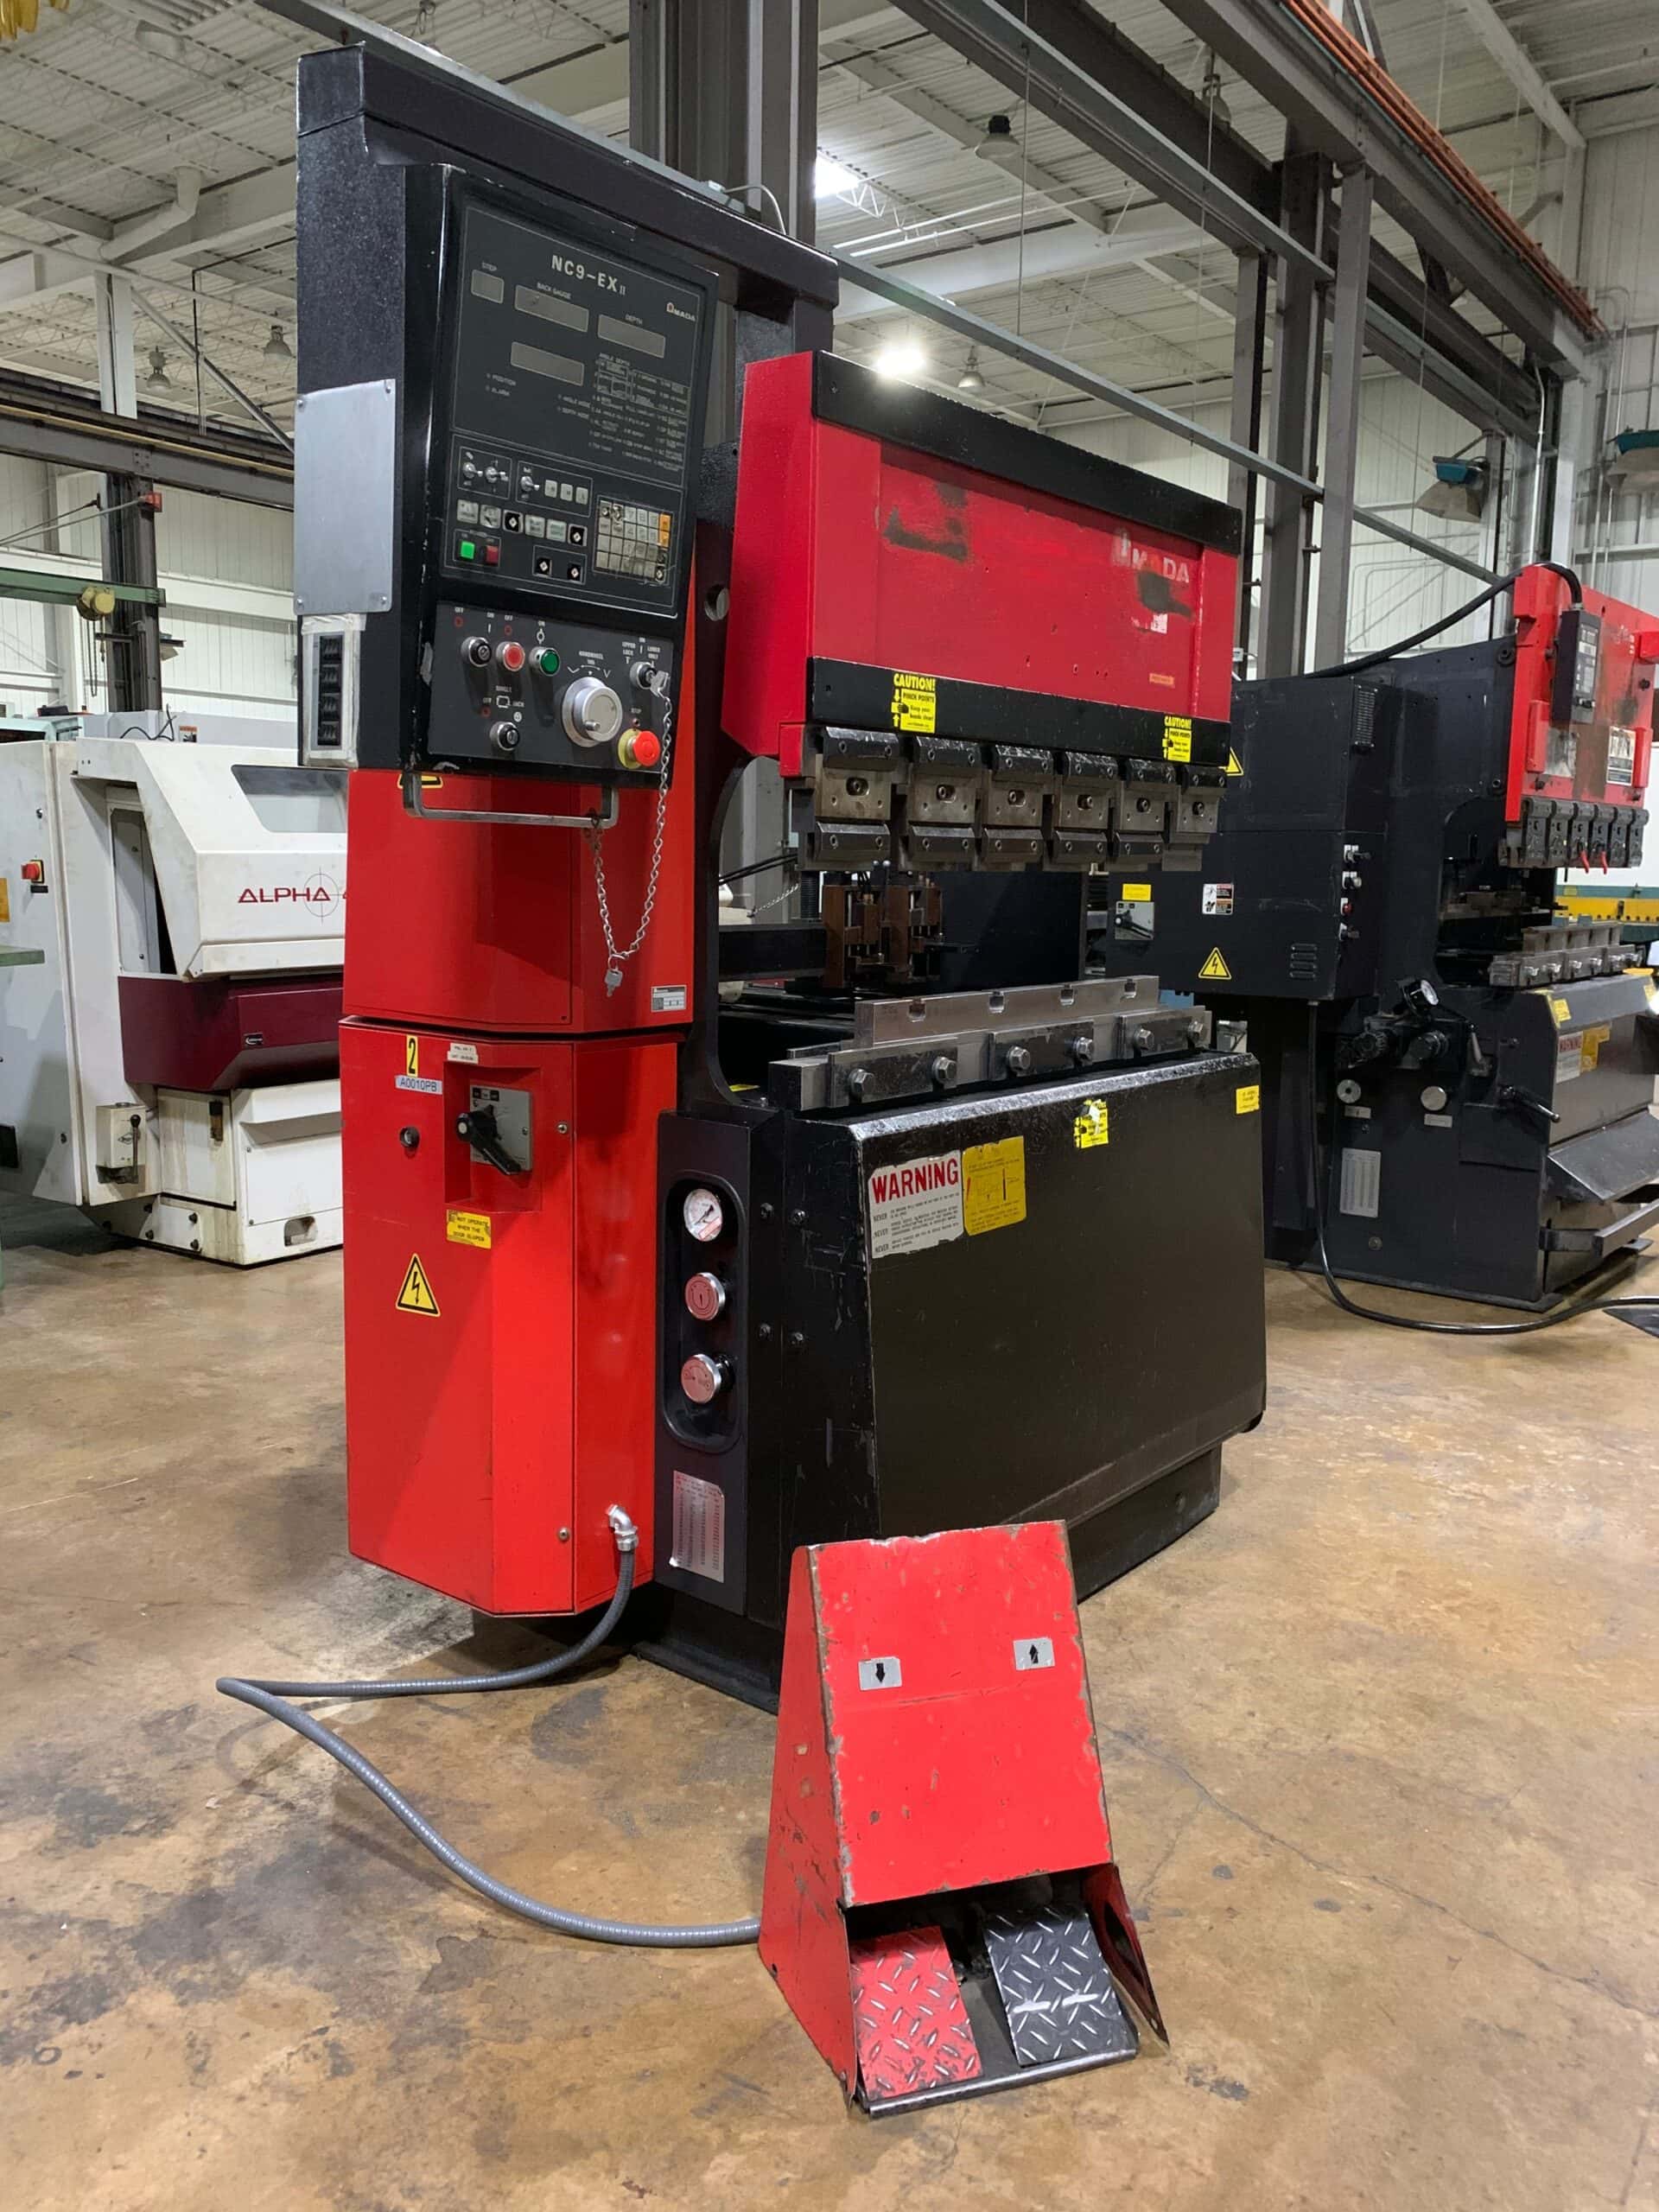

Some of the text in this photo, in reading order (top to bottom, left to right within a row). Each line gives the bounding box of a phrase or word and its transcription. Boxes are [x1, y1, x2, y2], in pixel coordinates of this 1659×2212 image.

[893, 672, 936, 692] CAUTION!
[238, 887, 331, 903] ALPHA
[408, 1037, 416, 1075] 2
[872, 1158, 958, 1205] WARNING
